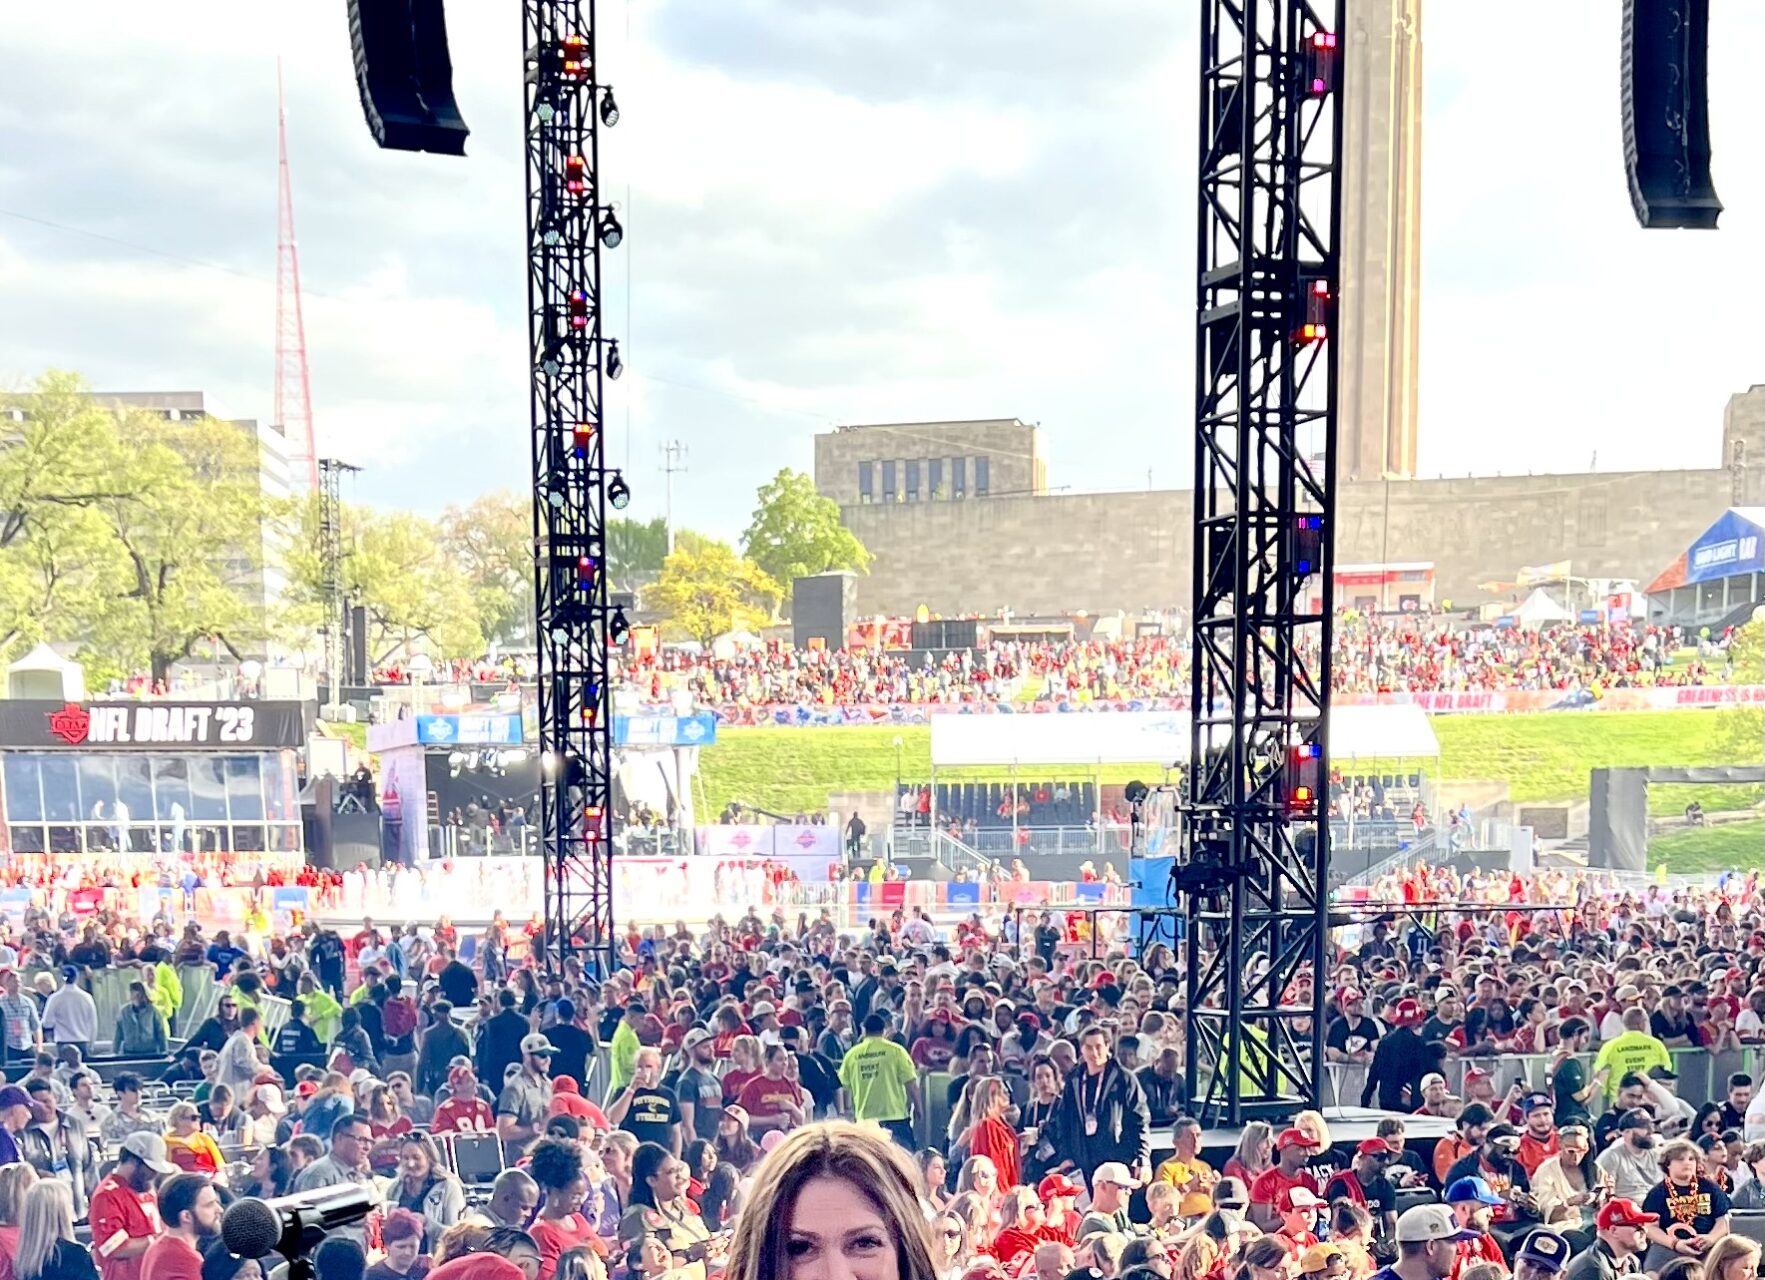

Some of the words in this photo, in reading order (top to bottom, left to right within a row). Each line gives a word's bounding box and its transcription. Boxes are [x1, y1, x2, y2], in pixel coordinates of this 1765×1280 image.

[1739, 536, 1757, 560] BAR
[1457, 694, 1492, 708] DRAFT
[88, 707, 130, 742] NFL
[134, 707, 212, 742] DRAFT
